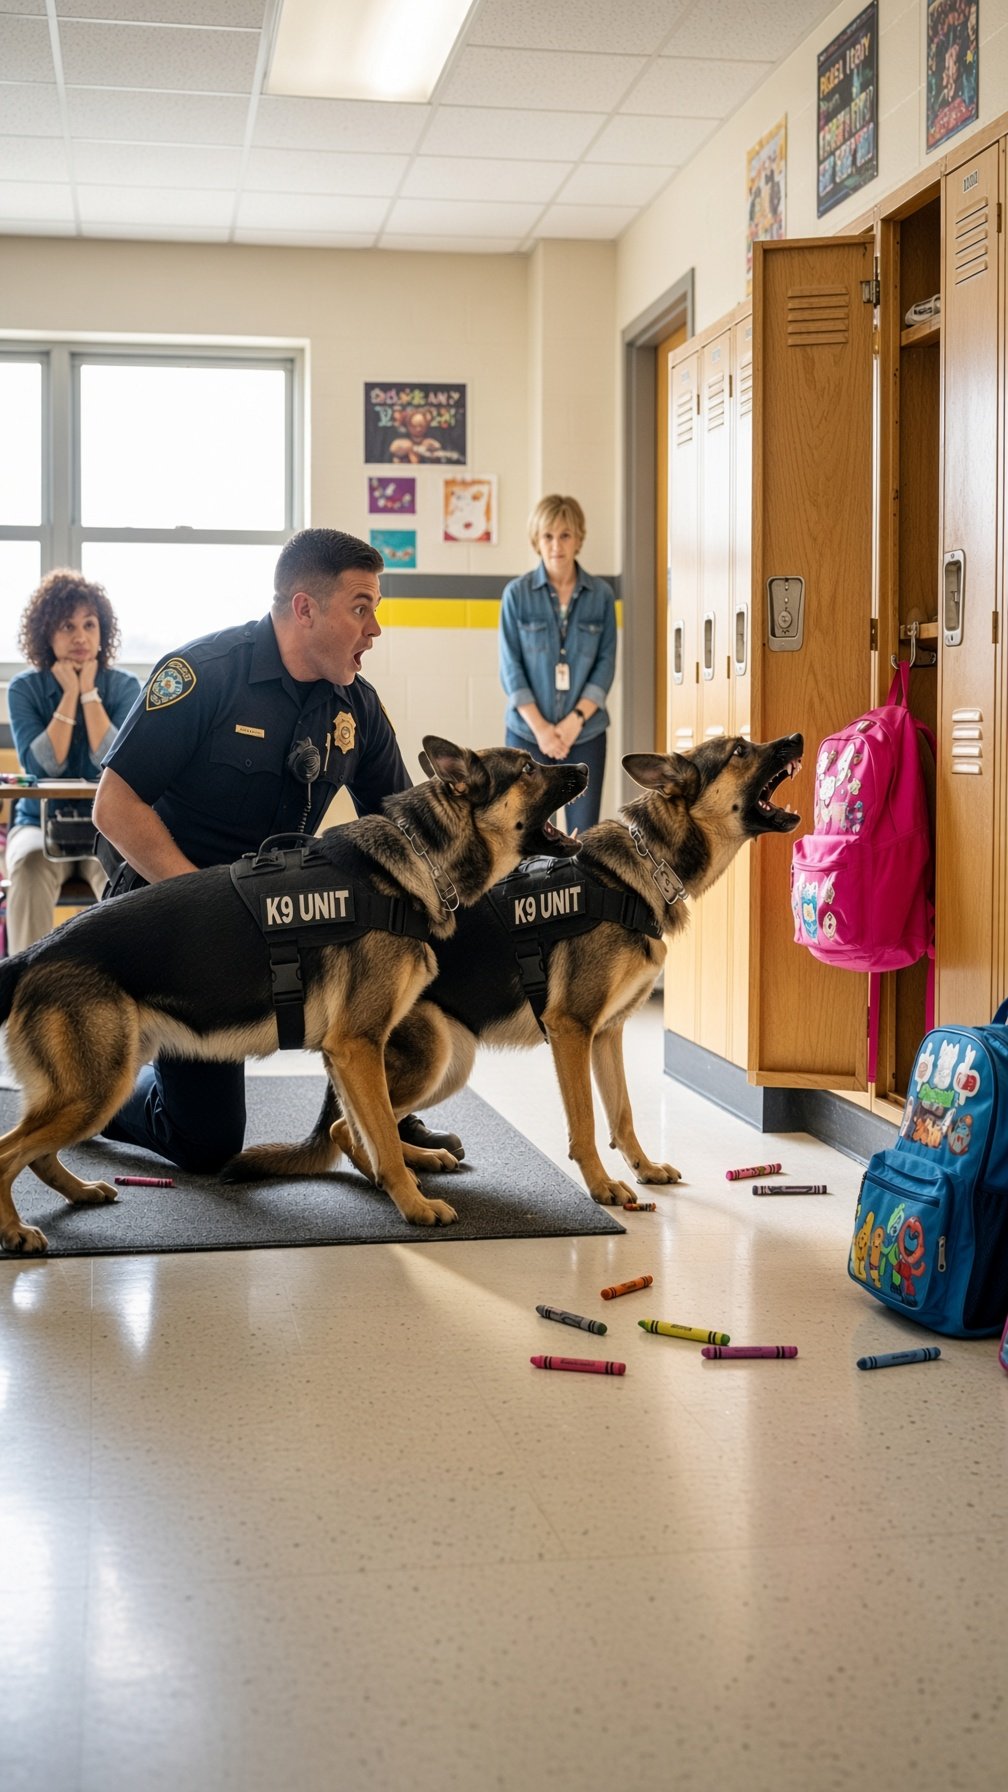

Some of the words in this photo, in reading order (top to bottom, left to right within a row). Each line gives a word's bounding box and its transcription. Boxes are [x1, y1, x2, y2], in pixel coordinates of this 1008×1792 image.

[266, 895, 294, 926] K9
[299, 890, 349, 921] UNIT
[514, 896, 536, 925] K9
[540, 885, 581, 919] UNIT
